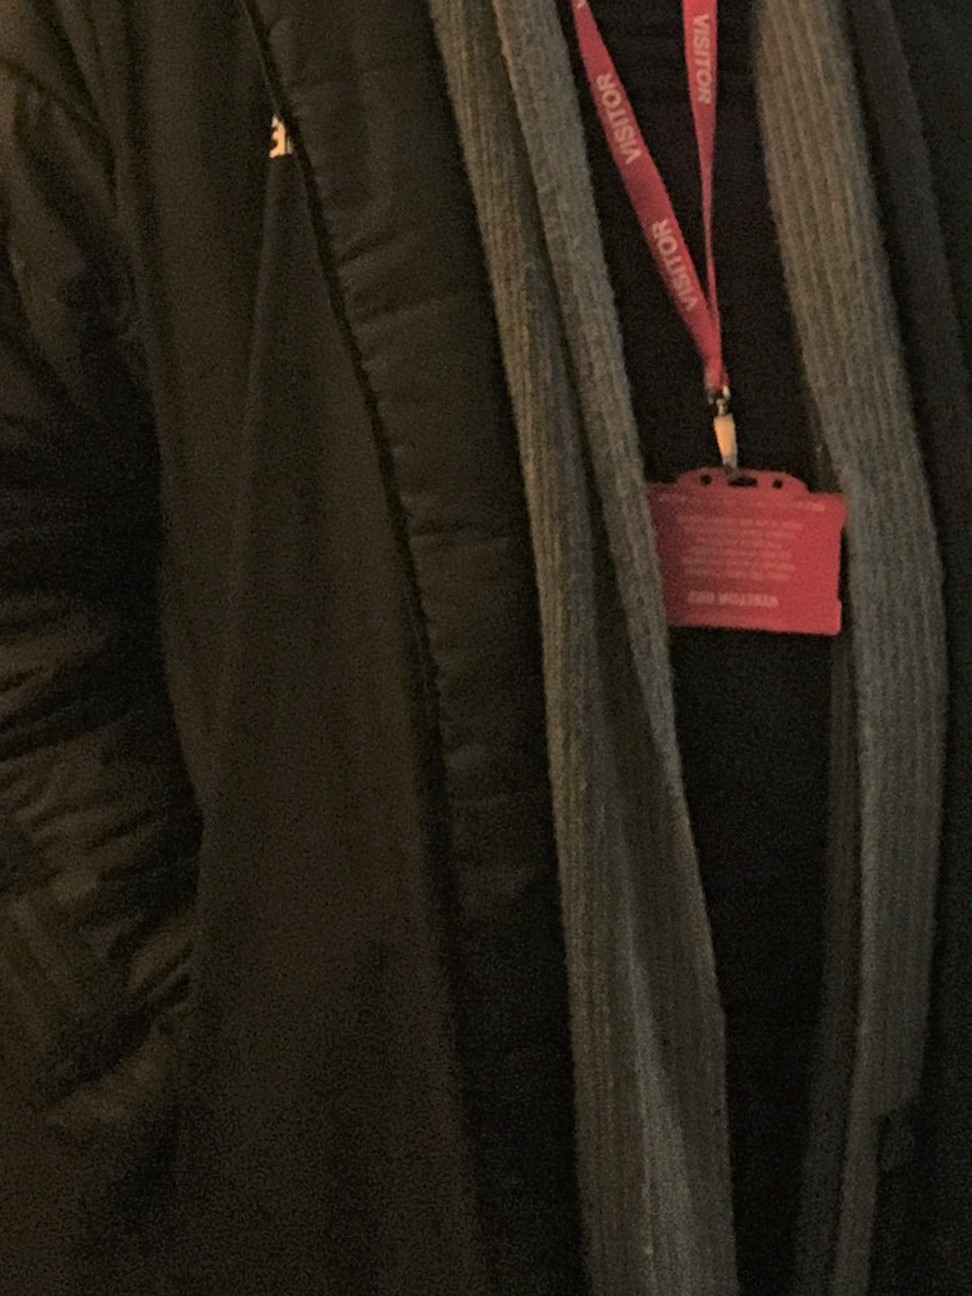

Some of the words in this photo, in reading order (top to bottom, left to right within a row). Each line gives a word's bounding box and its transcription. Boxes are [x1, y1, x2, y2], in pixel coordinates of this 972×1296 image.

[692, 14, 713, 104] VISITOR
[596, 73, 642, 165] VISITOR
[652, 219, 698, 312] VISITOR
